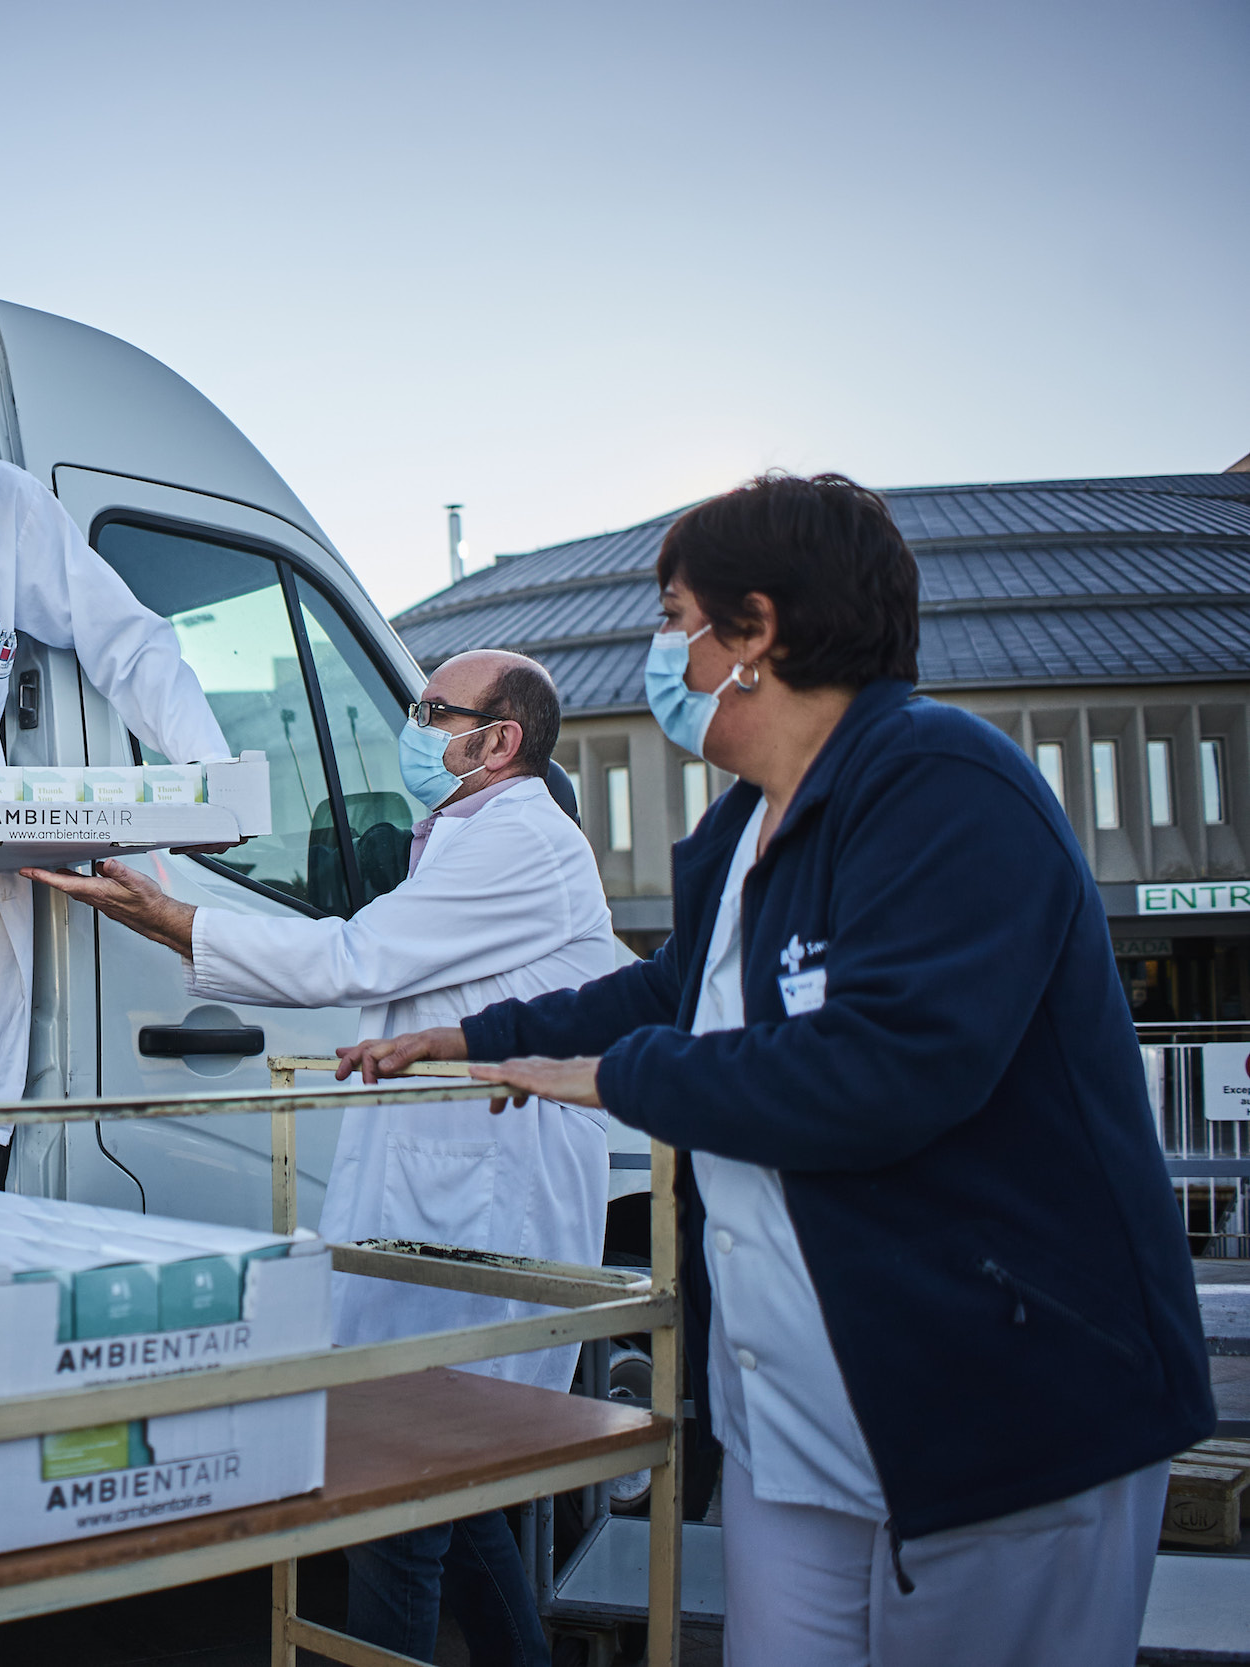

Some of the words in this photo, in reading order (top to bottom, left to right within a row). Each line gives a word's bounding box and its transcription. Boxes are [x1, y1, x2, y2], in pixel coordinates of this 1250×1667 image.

[37, 786, 63, 795] Thank
[97, 787, 124, 795] Thank
[157, 785, 183, 793] Thank
[8, 829, 111, 842] www.ambientair.es
[1145, 885, 1250, 911] ENTR
[55, 1326, 252, 1375] AMBIENTAIR
[45, 1453, 242, 1513] AMBIENTAIR
[75, 1492, 214, 1529] www.ambientair.es
